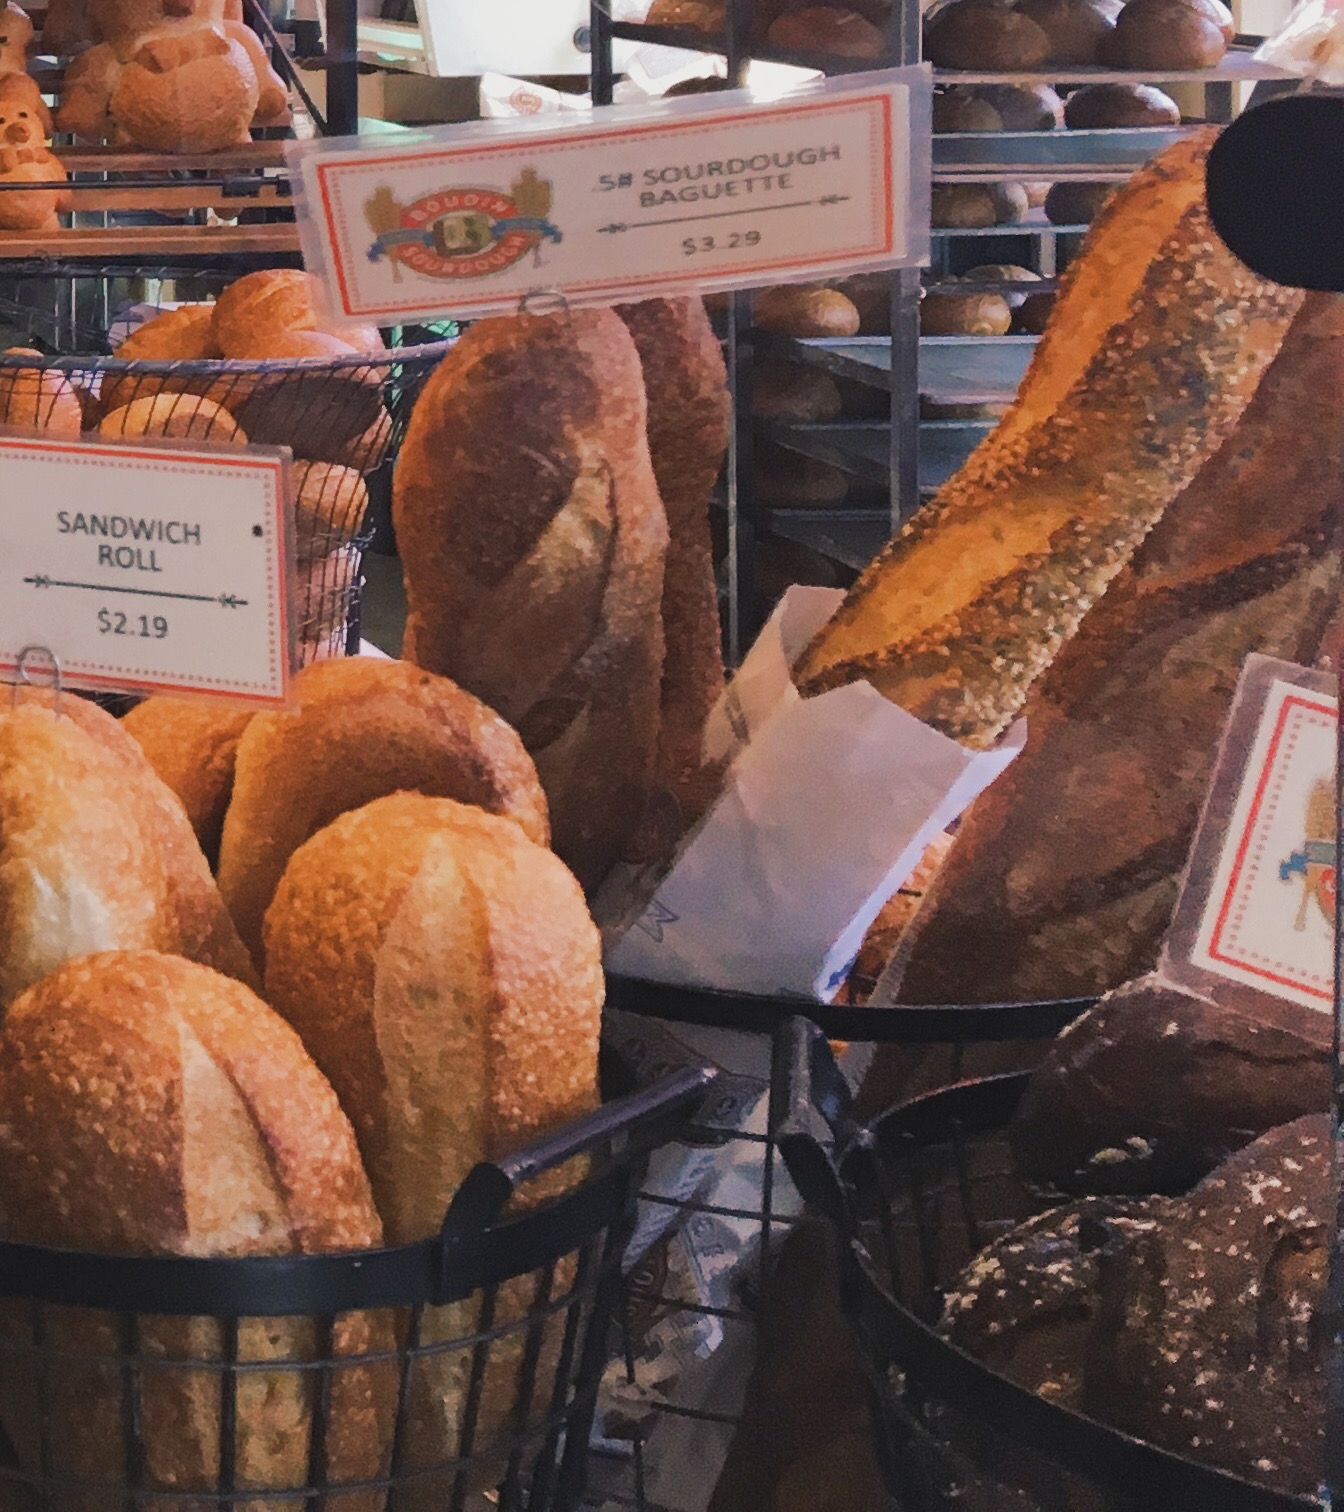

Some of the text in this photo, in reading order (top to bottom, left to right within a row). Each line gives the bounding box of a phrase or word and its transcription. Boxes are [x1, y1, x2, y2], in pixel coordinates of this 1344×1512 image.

[642, 144, 842, 188] SOURDOUGH
[639, 172, 795, 209] BAGUETTE
[56, 510, 202, 546] SANDWICH
[97, 543, 164, 573] ROLL
[97, 606, 169, 639] $2.19
